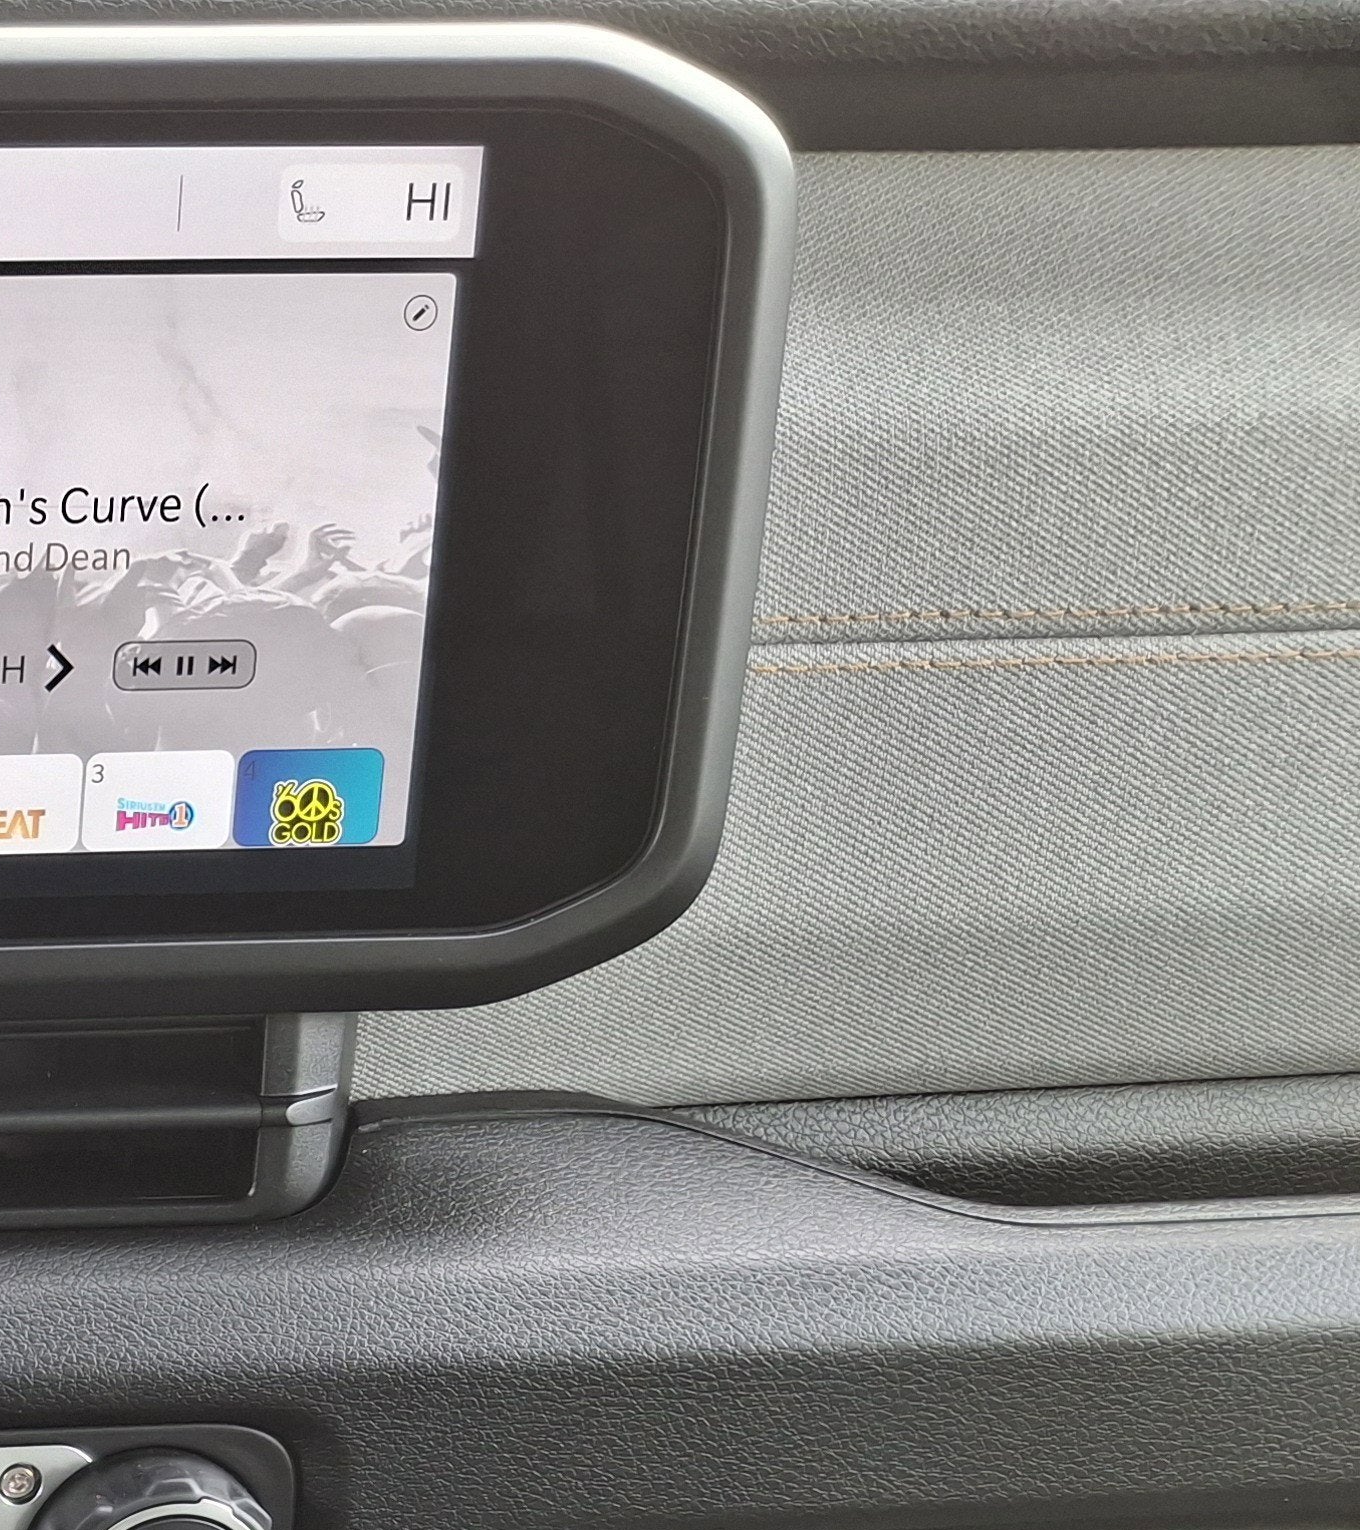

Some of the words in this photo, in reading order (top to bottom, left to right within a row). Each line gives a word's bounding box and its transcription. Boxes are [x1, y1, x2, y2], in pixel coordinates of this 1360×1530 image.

[406, 182, 450, 221] HI
[61, 487, 182, 524] Curve
[46, 542, 130, 571] Dean
[91, 764, 104, 783] 3
[272, 822, 340, 844] GOLD
